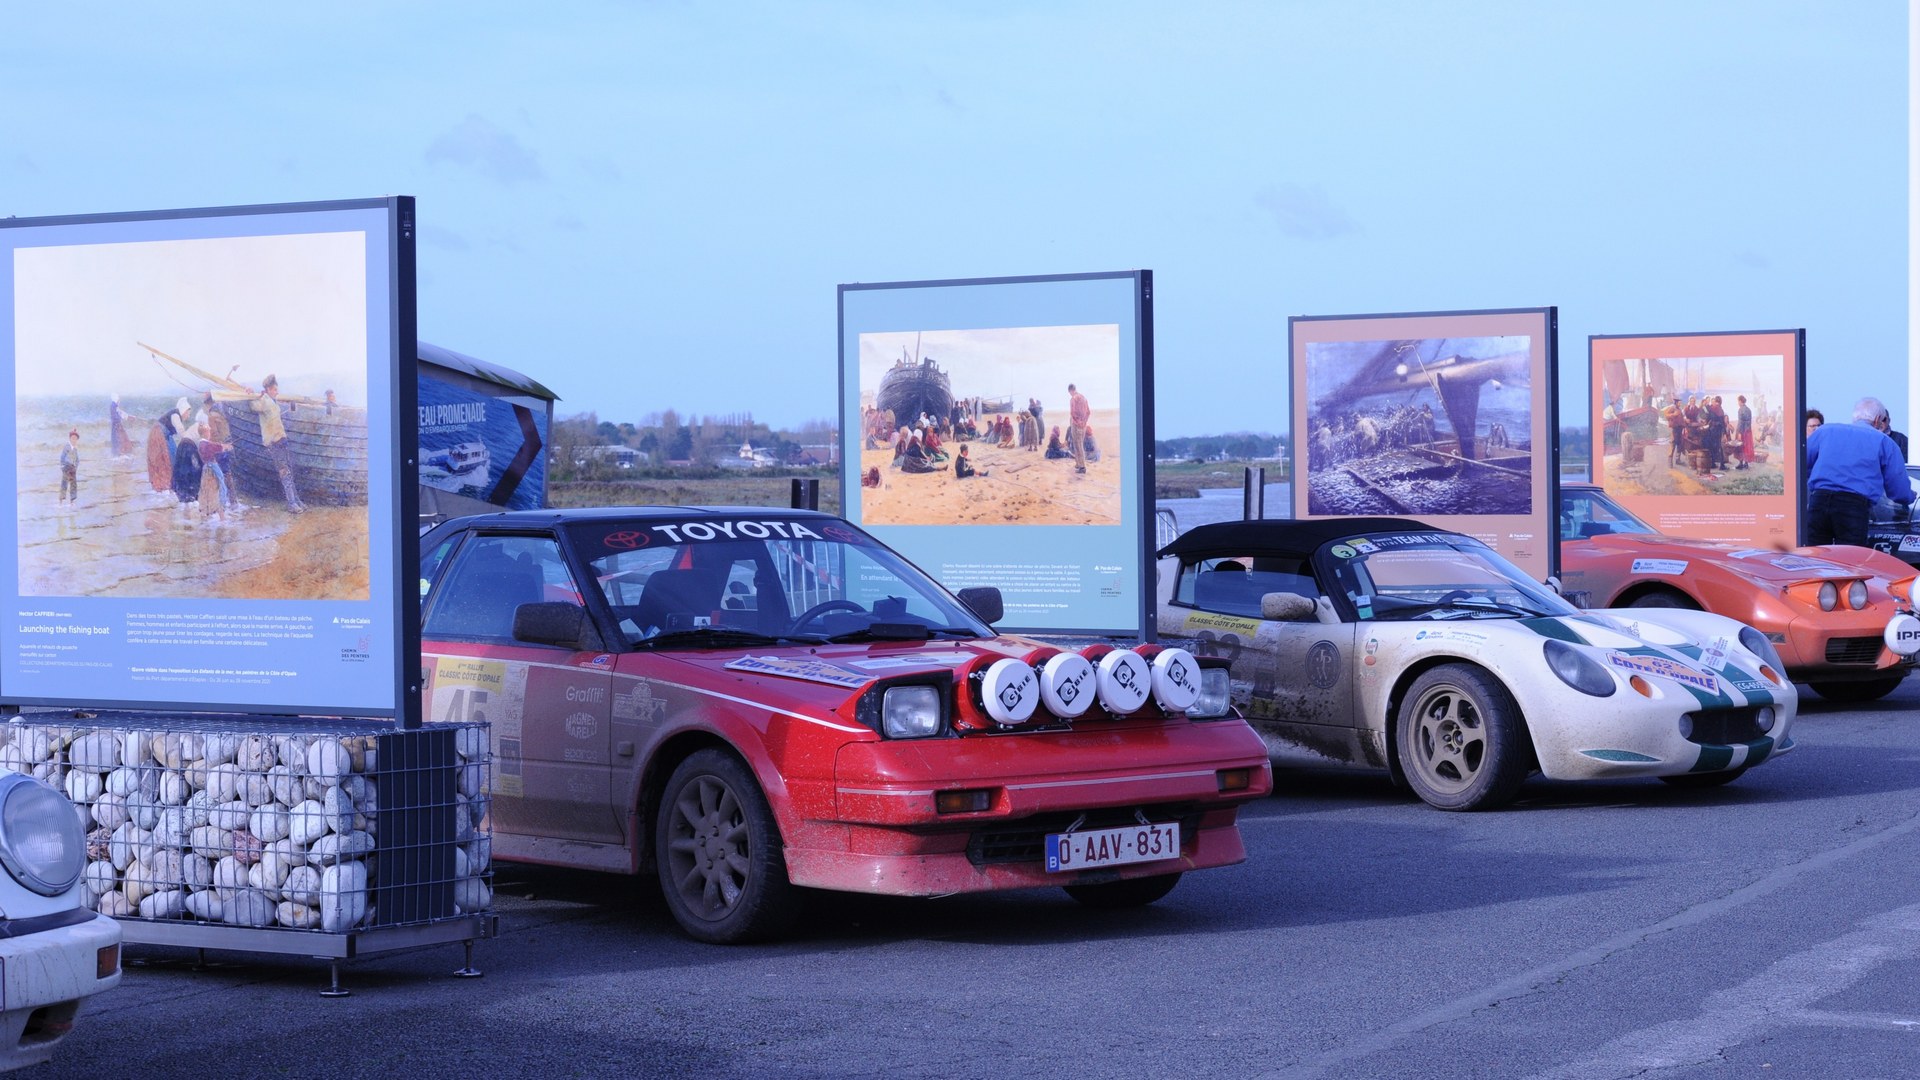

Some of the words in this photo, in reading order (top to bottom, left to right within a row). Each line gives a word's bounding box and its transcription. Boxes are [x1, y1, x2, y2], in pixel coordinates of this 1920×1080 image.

[437, 402, 486, 425] PROMENADE
[651, 521, 823, 543] TOYOTA
[1392, 535, 1426, 545] TEAM
[19, 624, 55, 635] Launching
[55, 625, 67, 633] the
[68, 625, 92, 636] fishing
[93, 625, 110, 635] boat
[1189, 617, 1214, 625] CLASSIC
[1230, 622, 1256, 630] D'OPALE
[467, 663, 485, 671] RALLYE
[1652, 660, 1673, 671] 62
[439, 669, 461, 679] CLASSIC
[462, 669, 477, 681] CÔTE
[477, 673, 501, 684] D'OPALE
[566, 685, 604, 704] Graffiti
[565, 711, 598, 727] MAGNETI
[565, 724, 598, 739] MARELLI
[1049, 856, 1058, 868] B
